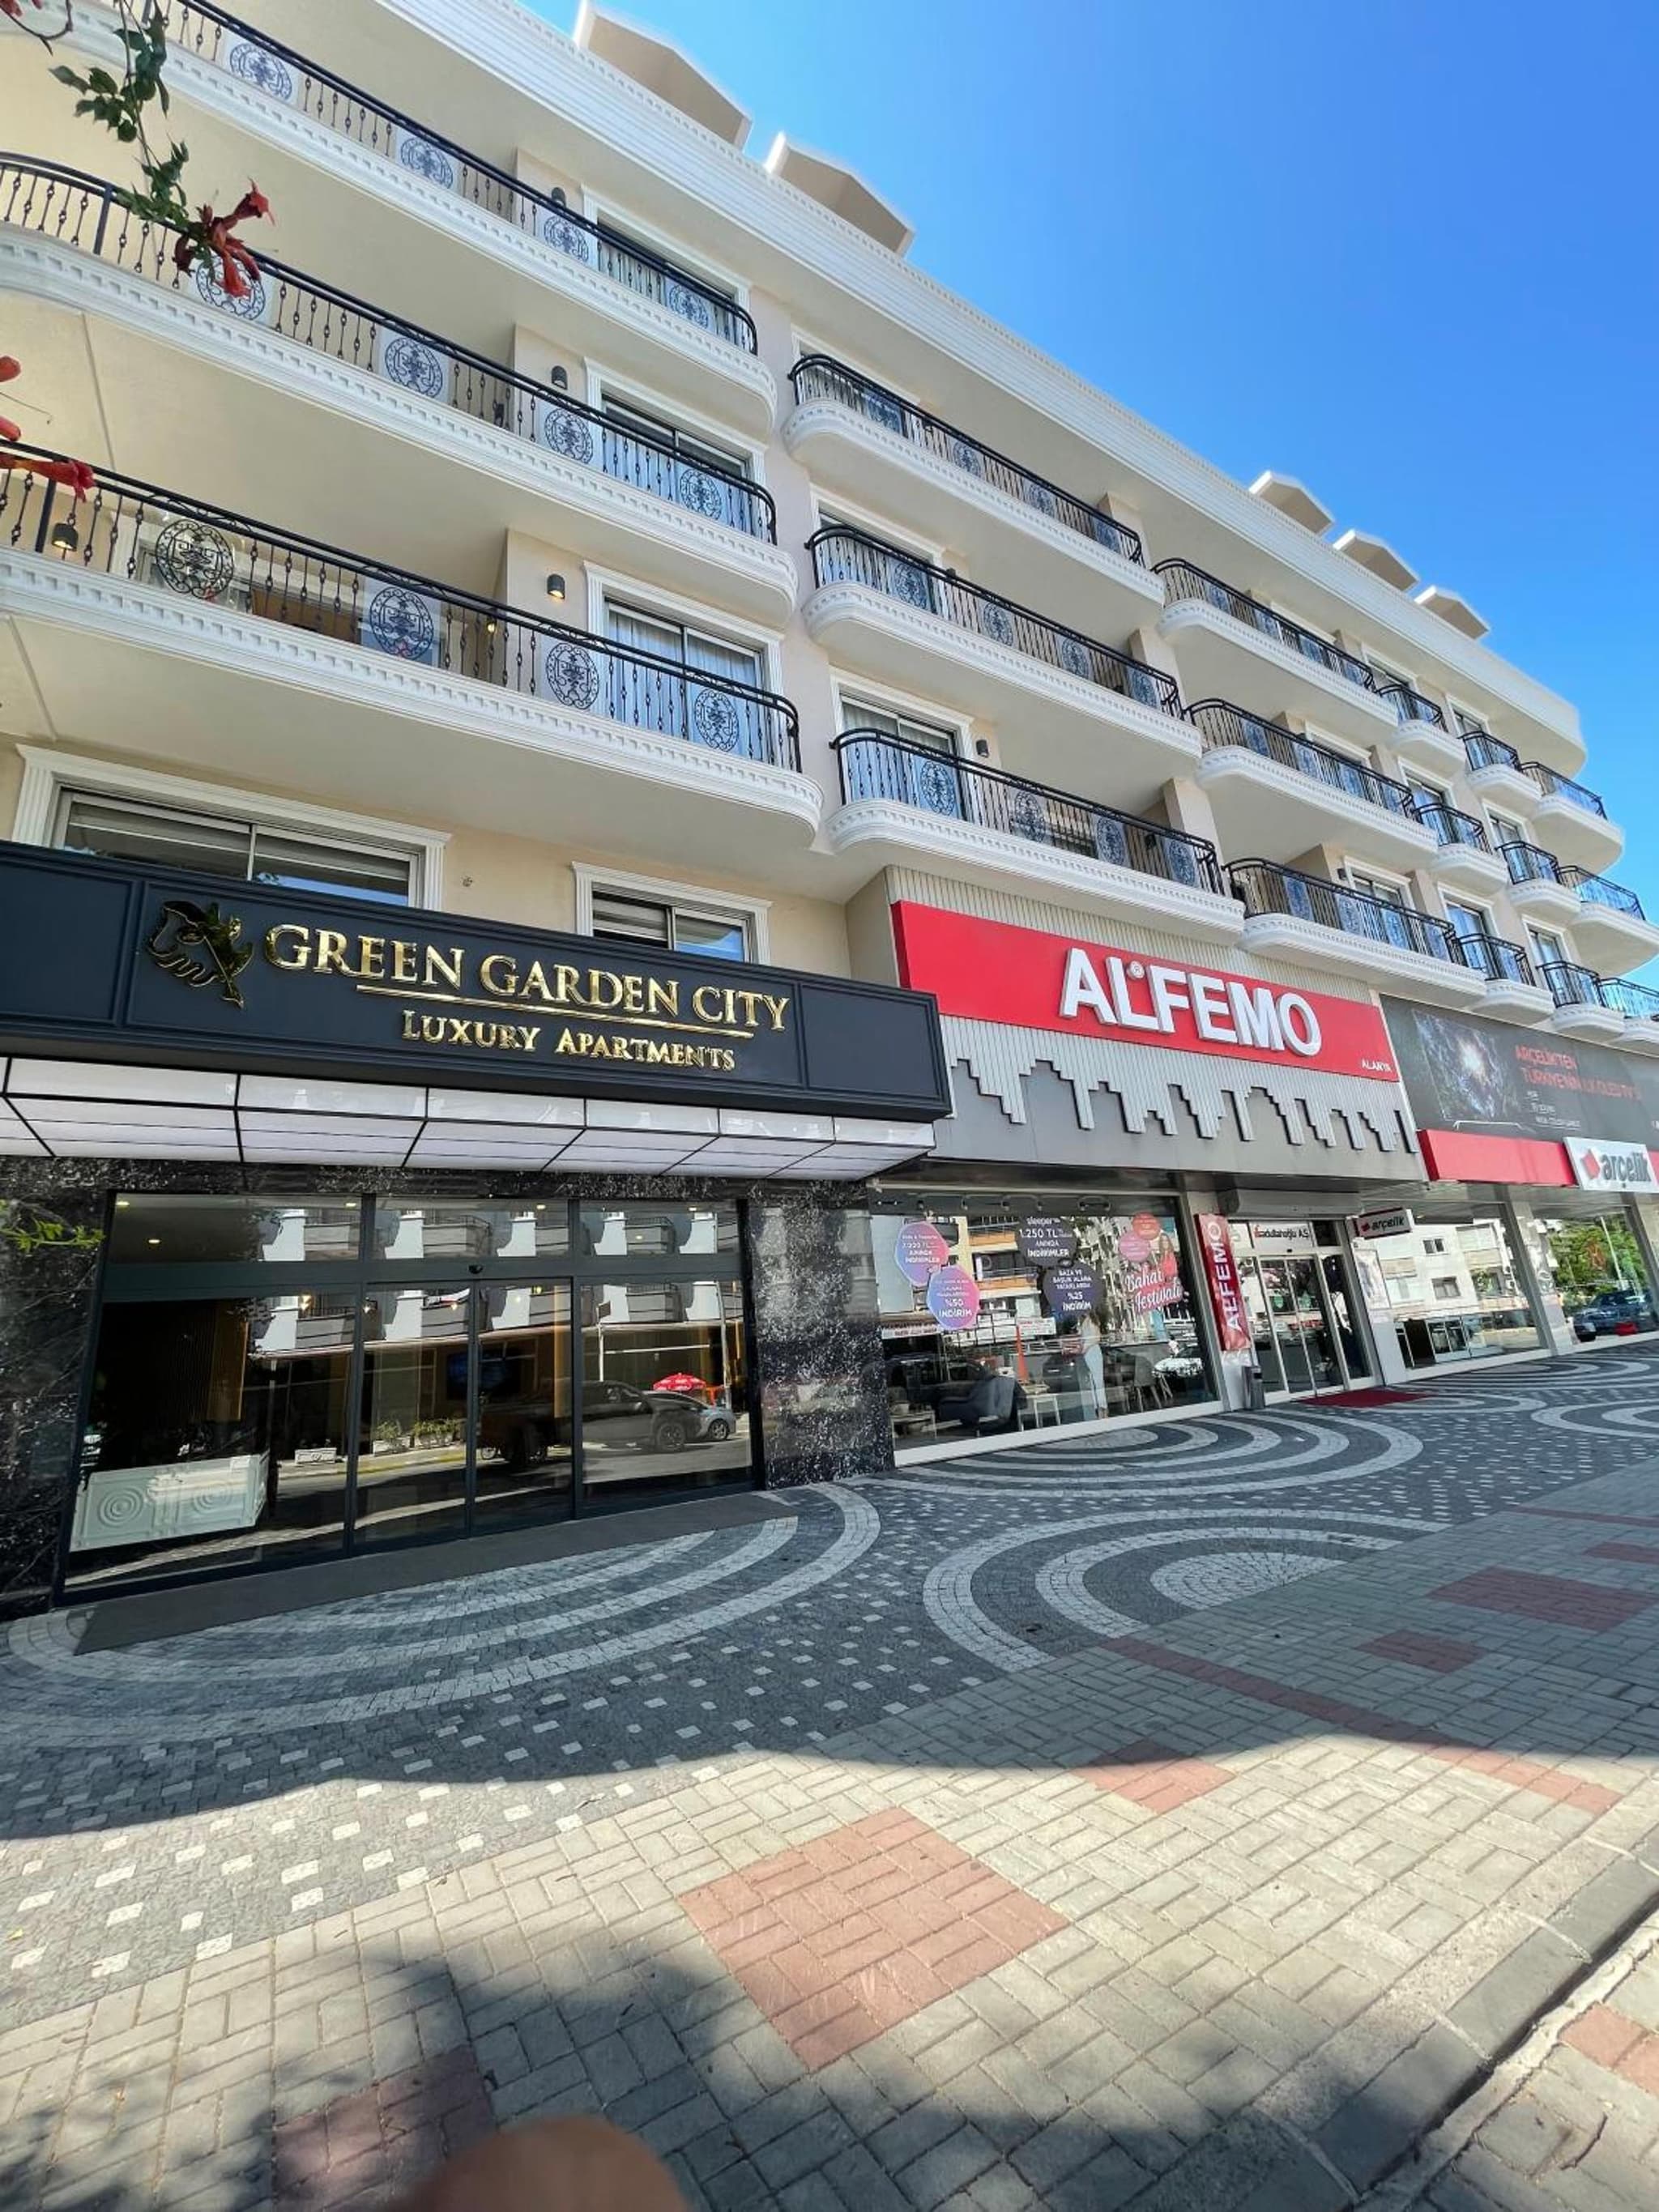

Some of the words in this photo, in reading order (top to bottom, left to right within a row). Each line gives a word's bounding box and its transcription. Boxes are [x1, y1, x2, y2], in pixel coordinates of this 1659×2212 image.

[266, 924, 465, 991] GREEN
[479, 954, 680, 1018] GARDEN
[691, 985, 790, 1031] CITY
[1059, 947, 1323, 1057] ALFEMO
[402, 1009, 541, 1052] LUXURY
[555, 1026, 736, 1072] APARTMENTS
